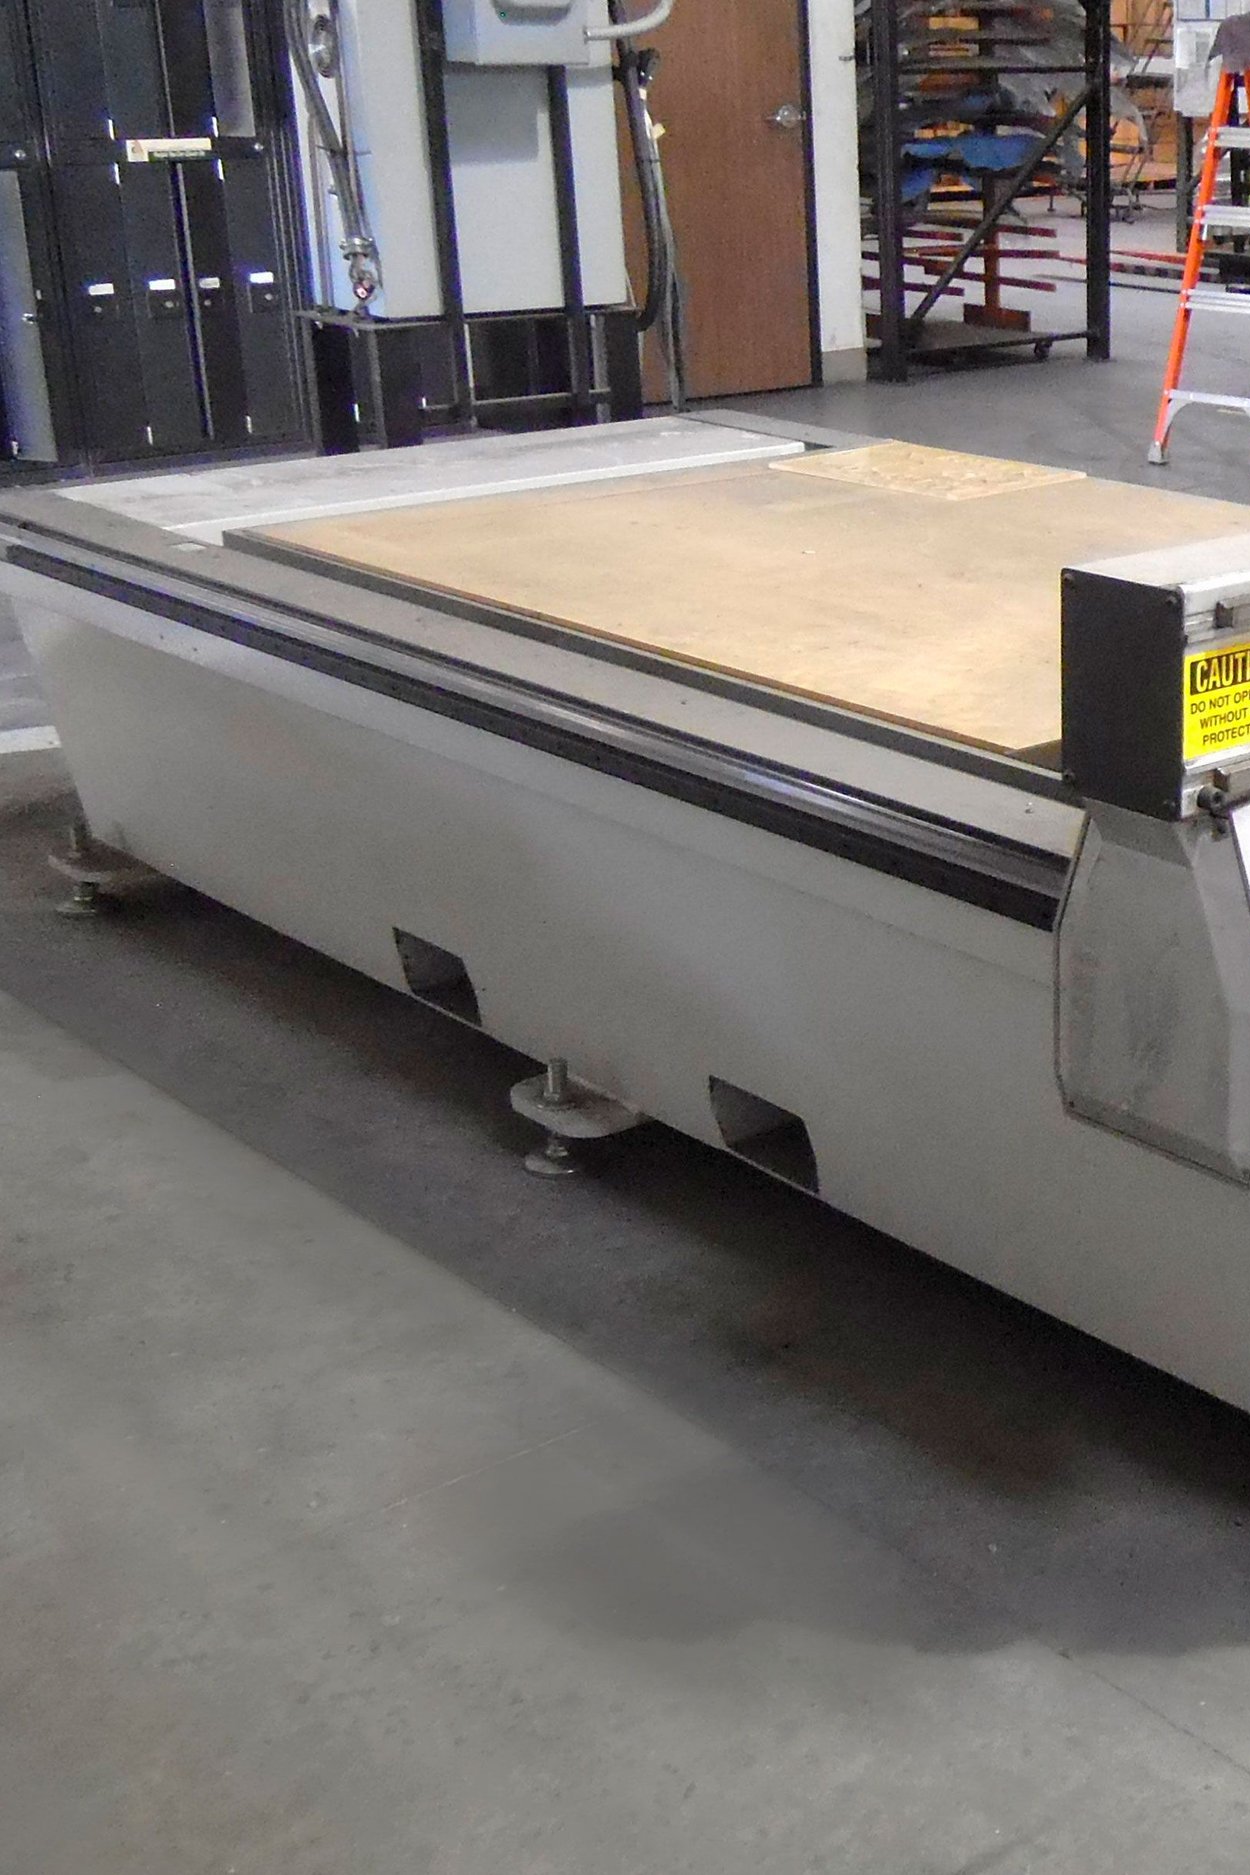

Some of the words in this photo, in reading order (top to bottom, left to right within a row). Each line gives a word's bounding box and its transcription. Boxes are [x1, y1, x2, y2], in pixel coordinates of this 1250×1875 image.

[1190, 700, 1206, 715] DO
[1209, 694, 1231, 710] NOT
[1199, 708, 1249, 730] WITHOUT
